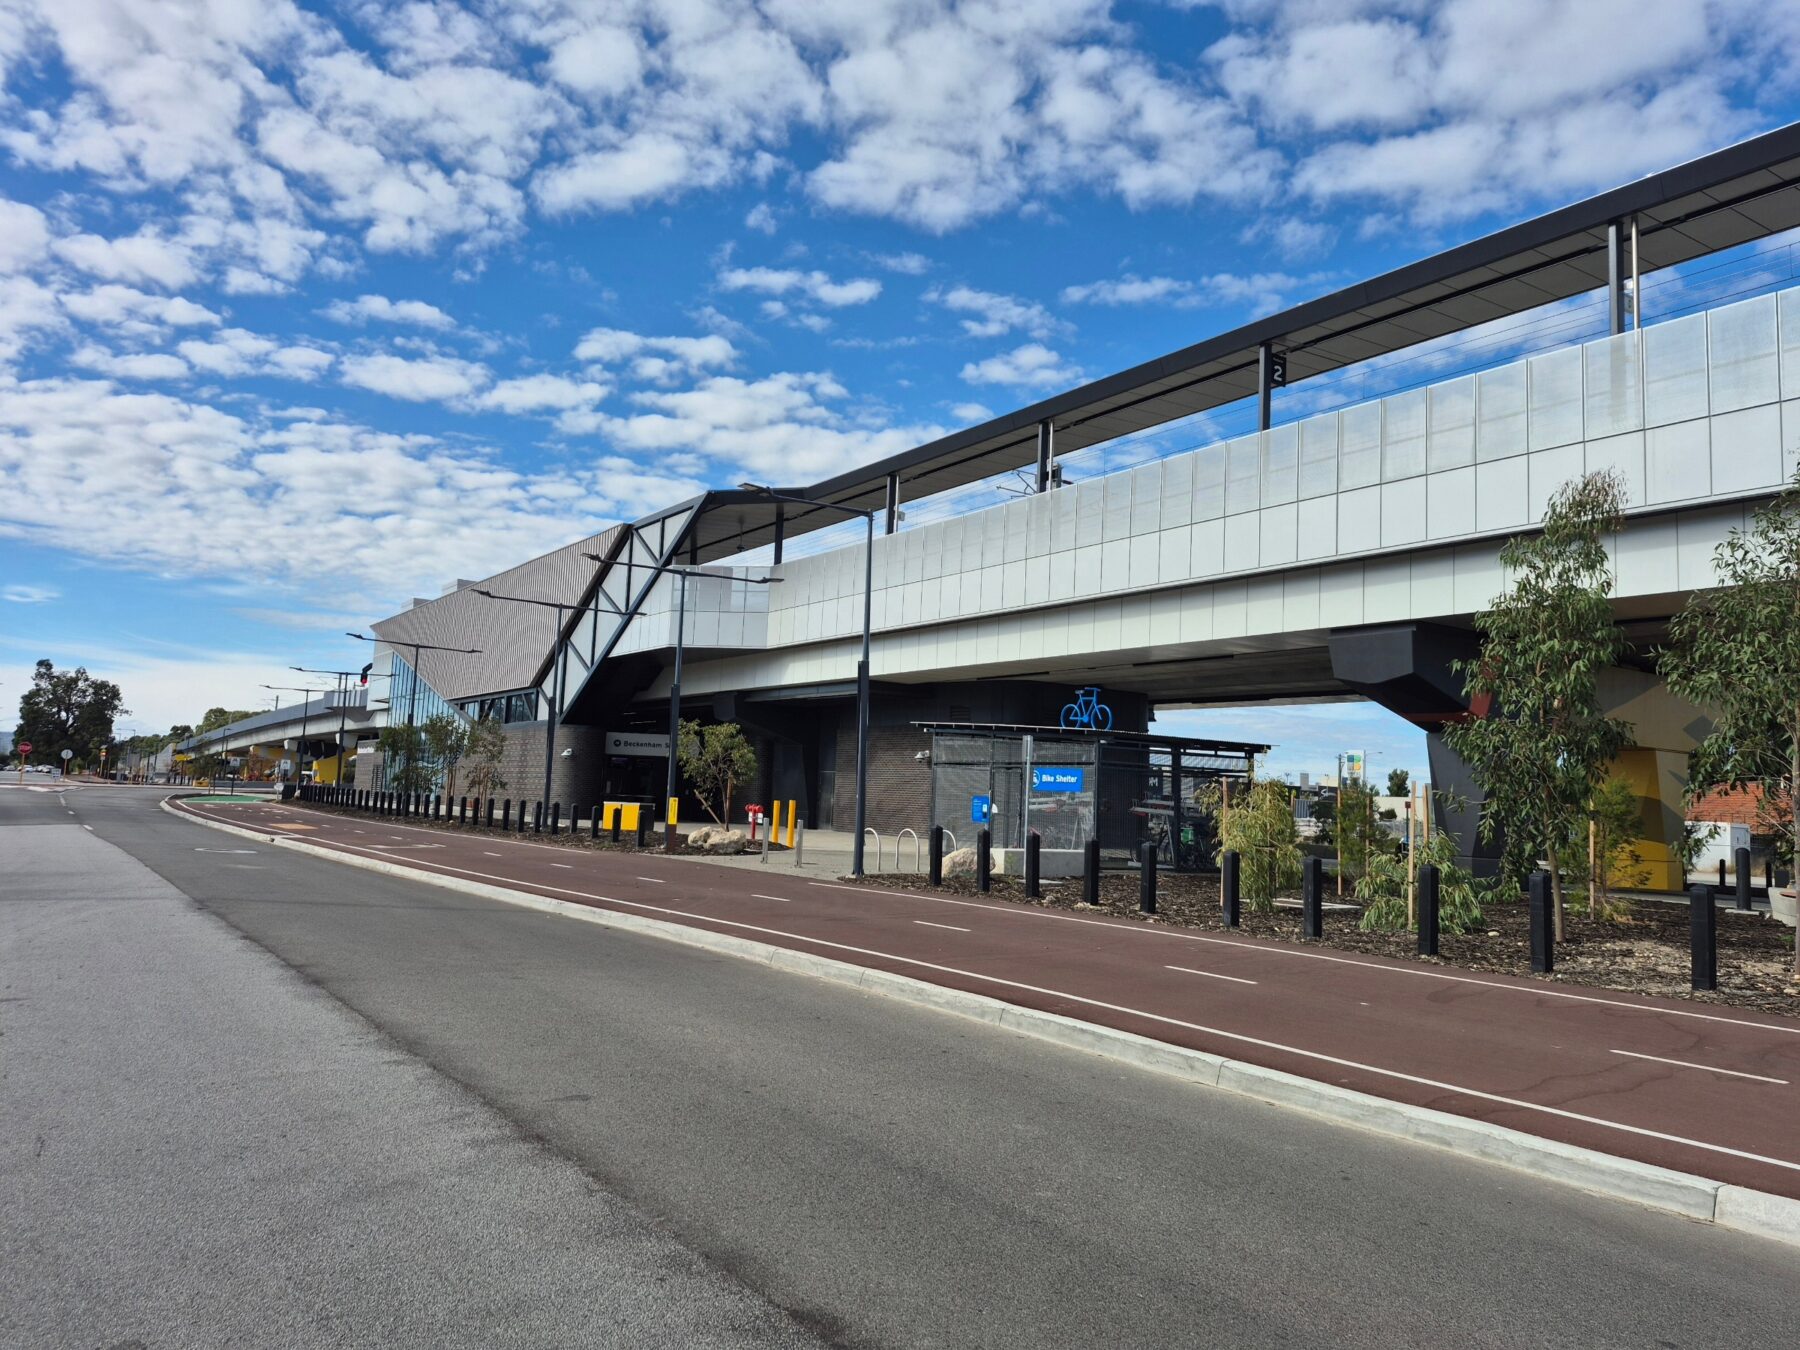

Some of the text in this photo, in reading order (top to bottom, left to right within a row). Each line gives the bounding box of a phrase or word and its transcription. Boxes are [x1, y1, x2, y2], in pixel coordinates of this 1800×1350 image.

[1273, 365, 1283, 382] 2
[623, 740, 662, 749] Beckenham
[1041, 774, 1078, 783] Bike Shelter
